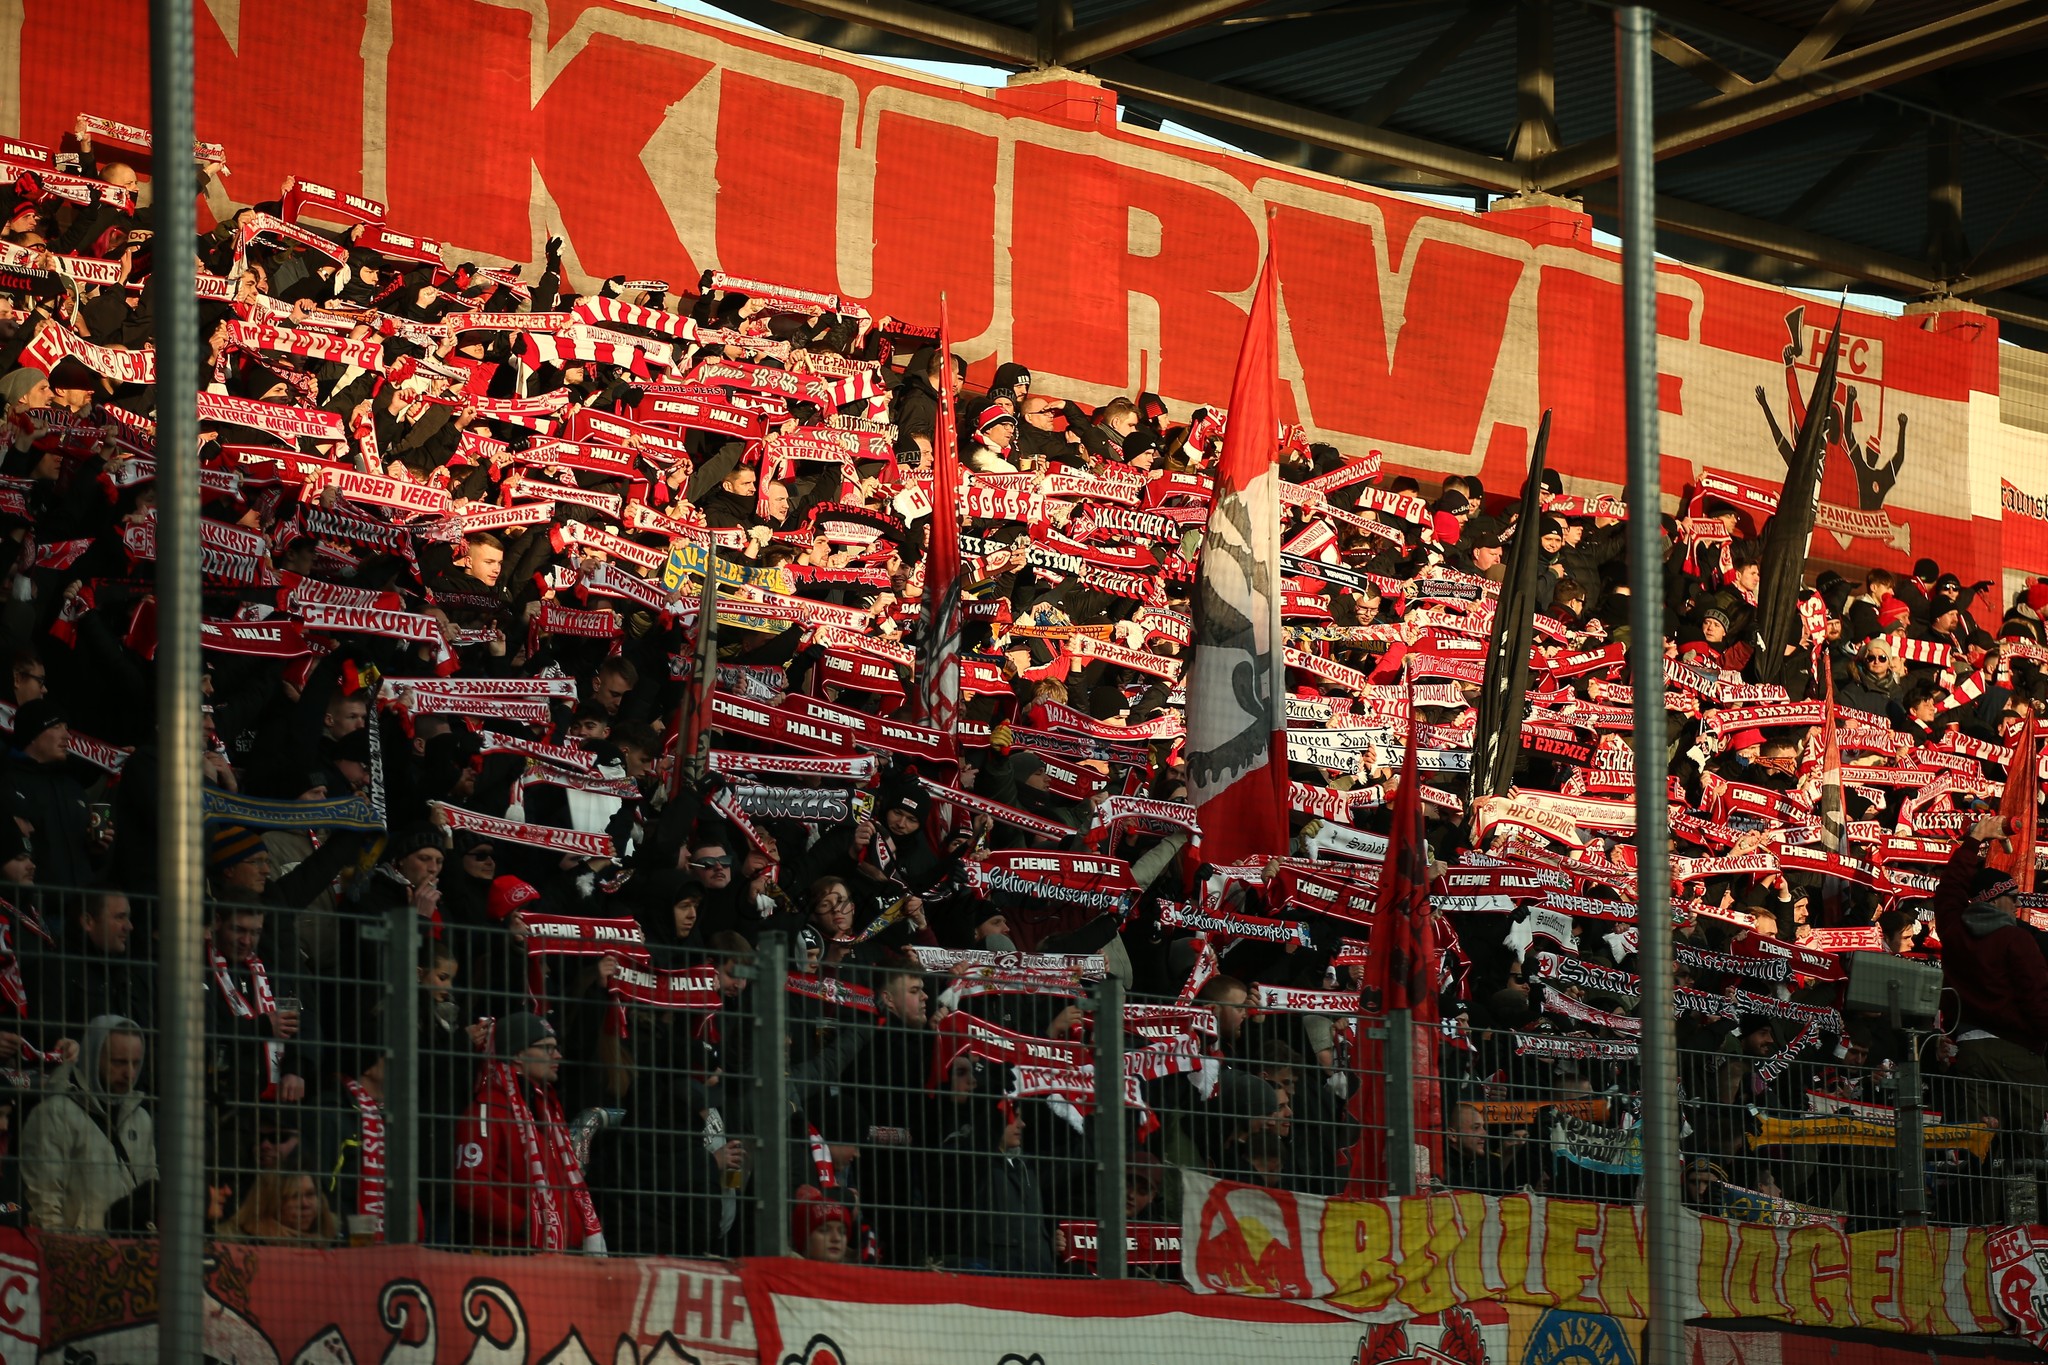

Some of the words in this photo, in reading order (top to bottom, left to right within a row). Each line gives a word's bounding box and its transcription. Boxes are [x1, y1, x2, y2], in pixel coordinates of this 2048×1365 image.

[3, 143, 48, 162] HALLE
[345, 194, 383, 218] HALLE
[380, 231, 415, 249] CHEMIE
[422, 241, 442, 256] HAL
[198, 396, 300, 421] ALLESCHER
[654, 400, 700, 416] CHEMIE
[709, 409, 749, 429] HALLE
[590, 419, 631, 440] CHEMIE
[641, 432, 685, 452] HALLE
[590, 446, 631, 464] HALLE
[339, 472, 397, 500] UNSER
[1701, 478, 1739, 496] CHEMIE
[581, 523, 667, 571] HFC-FANKUR
[605, 566, 667, 608] HFC-FANKU
[301, 604, 439, 640] C-FANKURVE
[762, 591, 854, 627] HFC-FNKURVE
[1427, 610, 1493, 635] HFC-FANKU
[231, 627, 282, 642] HALLE
[861, 664, 899, 682] HALLE
[1284, 647, 1365, 691] C-FANKURVE
[713, 698, 770, 727] CHEMIE
[787, 719, 843, 747] HALLE
[808, 703, 866, 731] CHEMIE
[882, 724, 941, 747] HALLE
[1731, 788, 1768, 806] CHEMIE
[1506, 803, 1535, 821] HFC
[1535, 808, 1574, 839] CHEMIE
[1887, 838, 1918, 852] CHEMIE
[1924, 841, 1953, 855] HALLE
[1009, 857, 1061, 872] CHEMIE
[1073, 859, 1121, 877] HALLE
[1780, 844, 1828, 862] CHEMIE
[1839, 858, 1881, 880] HALLE
[987, 866, 1033, 896] Sektion
[1035, 875, 1112, 910] Weissenfels
[1448, 873, 1491, 887] CHEMIE
[1296, 879, 1339, 903] CHEMIE
[1348, 895, 1377, 913] HALL
[529, 923, 581, 939] CHEMIE
[594, 926, 642, 943] HALLE
[1759, 940, 1794, 959] CHEMIE
[1800, 950, 1833, 970] HALLE
[669, 976, 714, 992] HALLE
[1286, 993, 1361, 1012] HFC-FANK
[967, 1024, 1016, 1052] CHEMIE
[1027, 1043, 1073, 1064] HALLE
[672, 1272, 747, 1342] HF
